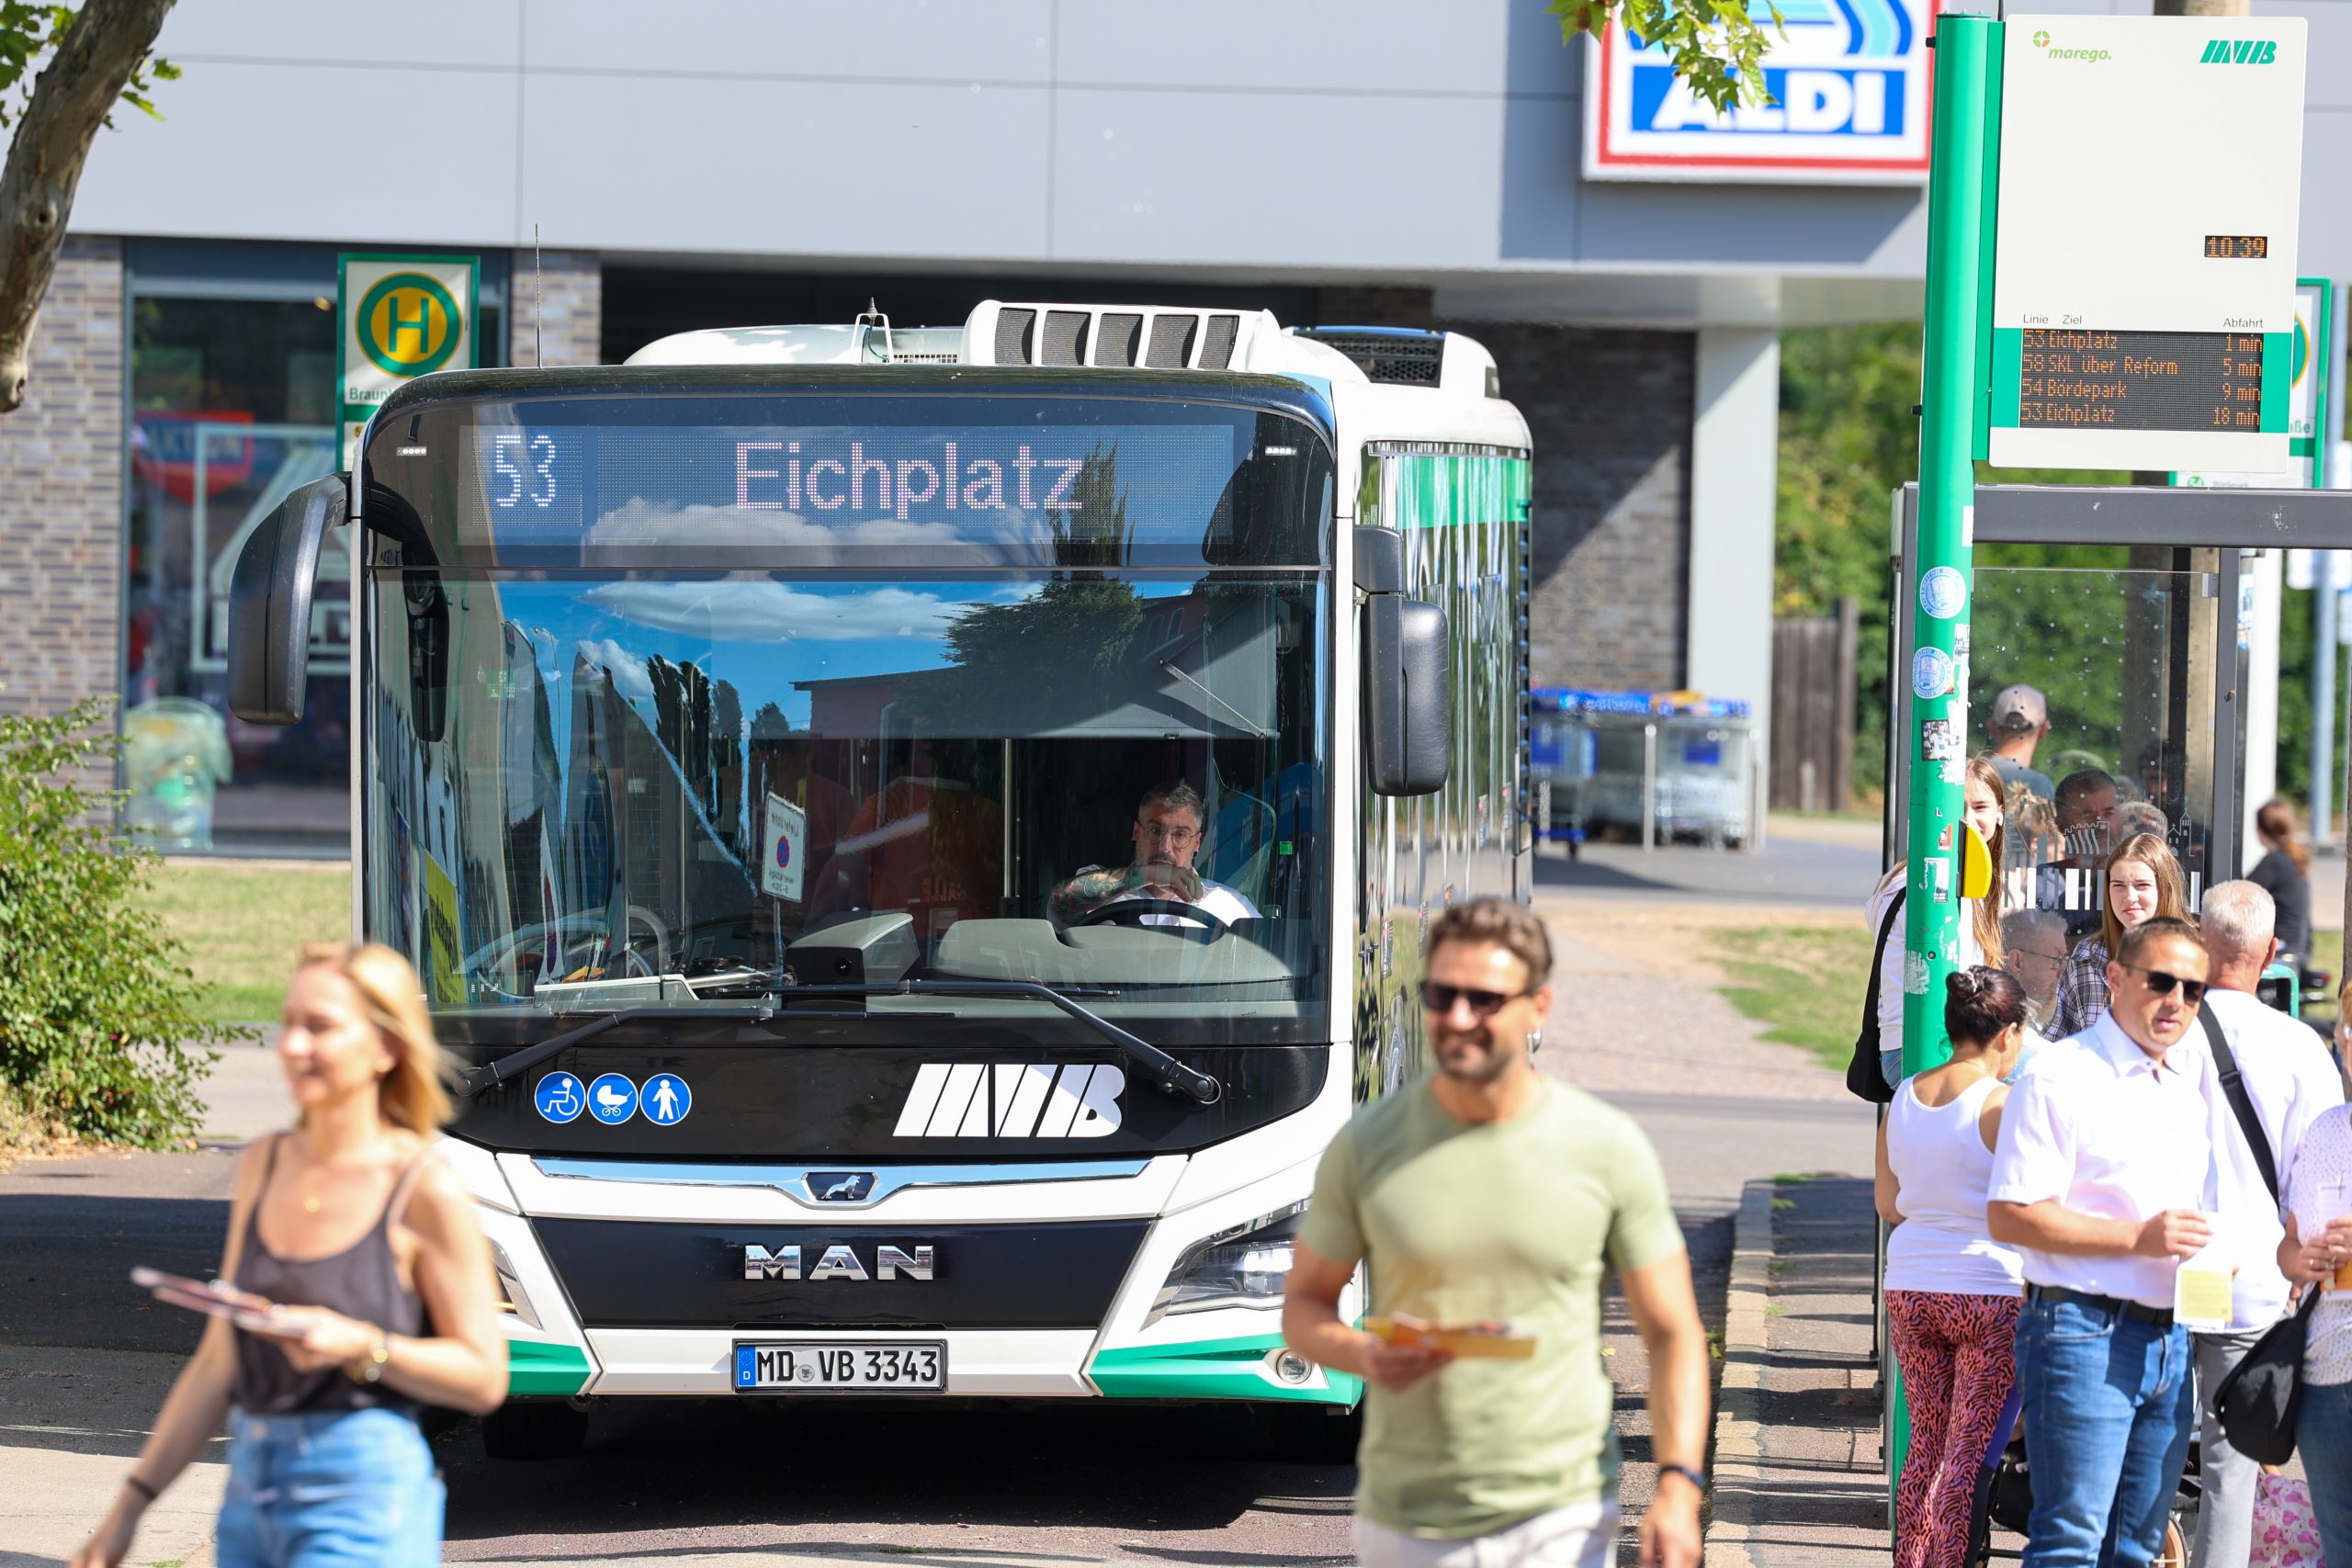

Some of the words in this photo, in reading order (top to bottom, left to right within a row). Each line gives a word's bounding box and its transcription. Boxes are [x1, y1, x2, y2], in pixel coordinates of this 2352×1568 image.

[2048, 46, 2111, 62] marego.
[1651, 69, 1886, 134] ALDI
[2022, 314, 2049, 324] Linie
[2062, 314, 2083, 325] Ziel
[2222, 317, 2264, 329] Abfahrt
[2023, 330, 2045, 349] 53
[2048, 331, 2118, 353] Eichplatz
[2224, 333, 2233, 352] 1
[2238, 333, 2263, 352] min
[2022, 354, 2044, 373] 58
[2048, 355, 2074, 373] SKL
[2081, 355, 2117, 375] über
[2123, 355, 2179, 378] Reform
[2222, 357, 2233, 377] 5
[2237, 358, 2262, 377] min
[2021, 378, 2044, 398] 54
[2047, 378, 2128, 401] Bördepark
[2222, 382, 2232, 400] 9
[2236, 383, 2261, 401] min
[2020, 402, 2043, 422] 53
[2046, 403, 2115, 425] Eichplatz
[2212, 407, 2230, 424] 18
[2235, 408, 2260, 426] min
[496, 434, 556, 508] 53
[735, 442, 1083, 521] Eichplatz
[892, 1063, 1126, 1138] MVB
[744, 1245, 934, 1281] MAN
[757, 1350, 795, 1382] MD
[819, 1350, 855, 1382] VB
[865, 1350, 937, 1382] 3343
